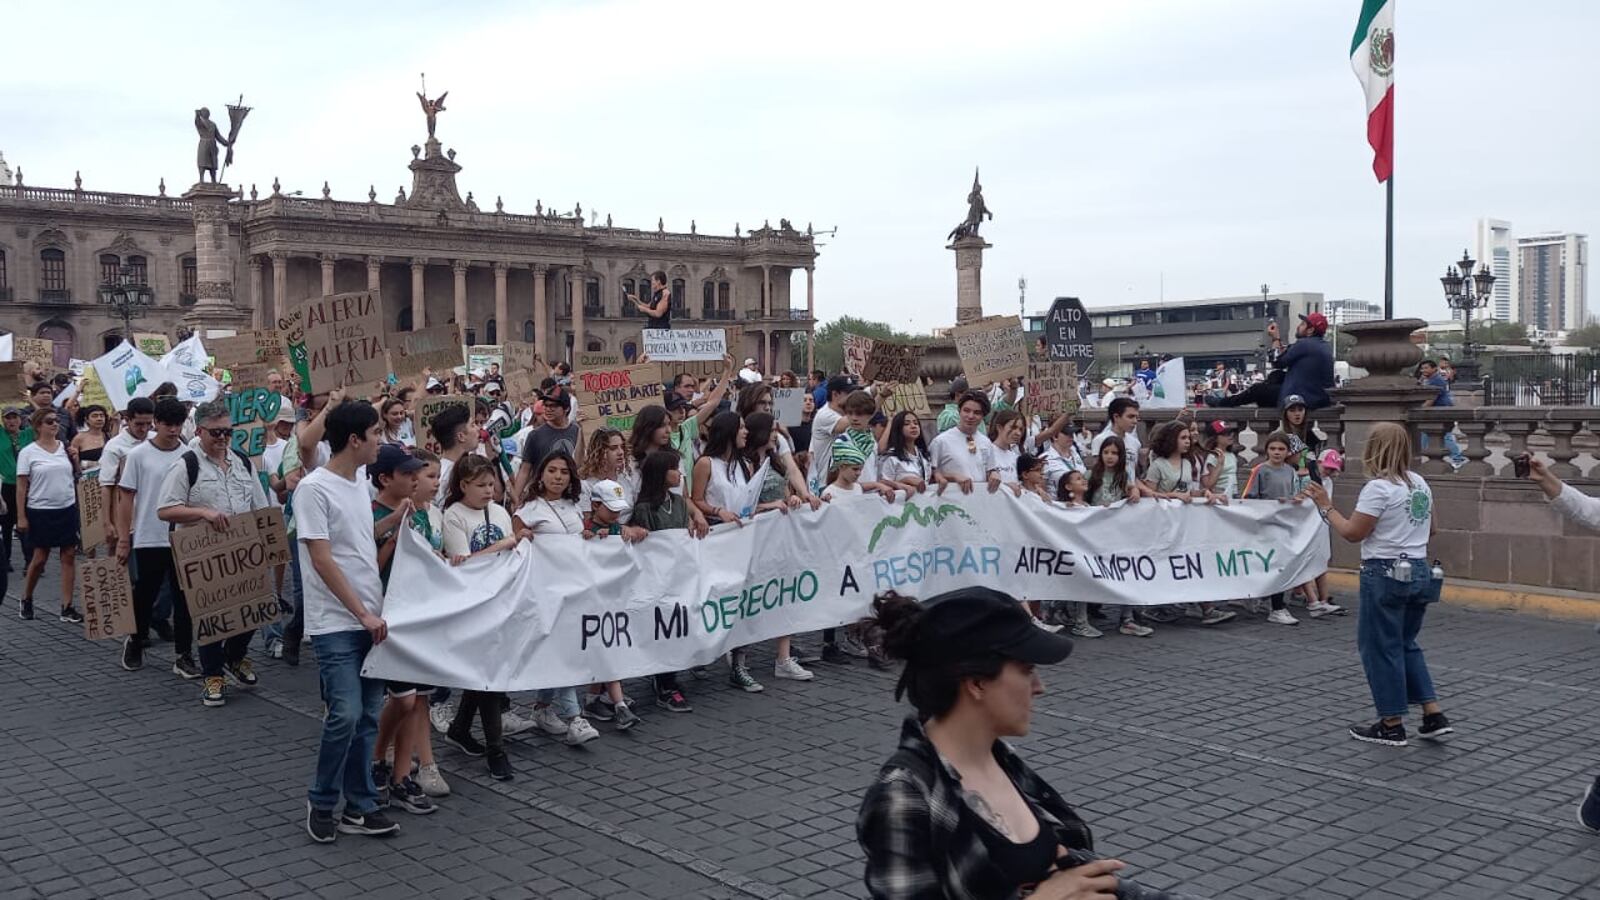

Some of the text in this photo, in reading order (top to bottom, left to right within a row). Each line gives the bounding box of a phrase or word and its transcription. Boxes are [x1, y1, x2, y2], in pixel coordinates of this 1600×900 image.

[308, 293, 376, 329] ALERTA
[1052, 308, 1082, 323] ALTO
[1059, 326, 1076, 340] EN
[311, 335, 385, 372] ALERTA
[1050, 343, 1095, 358] AZUFRE
[580, 369, 632, 393] TODOS
[594, 383, 661, 404] SOMOS PARTE
[224, 387, 281, 427] IERO
[598, 403, 632, 417] DE LA
[257, 515, 277, 530] EL
[184, 542, 264, 590] FUTURO
[195, 573, 265, 609] Queremos
[581, 610, 632, 651] POR
[654, 601, 689, 641] MI
[839, 564, 860, 597] A
[1014, 545, 1076, 577] AIRE
[1084, 552, 1157, 582] LIMPIO
[1168, 551, 1204, 581] EN
[1215, 548, 1276, 578] MTY
[198, 610, 236, 640] AIRE
